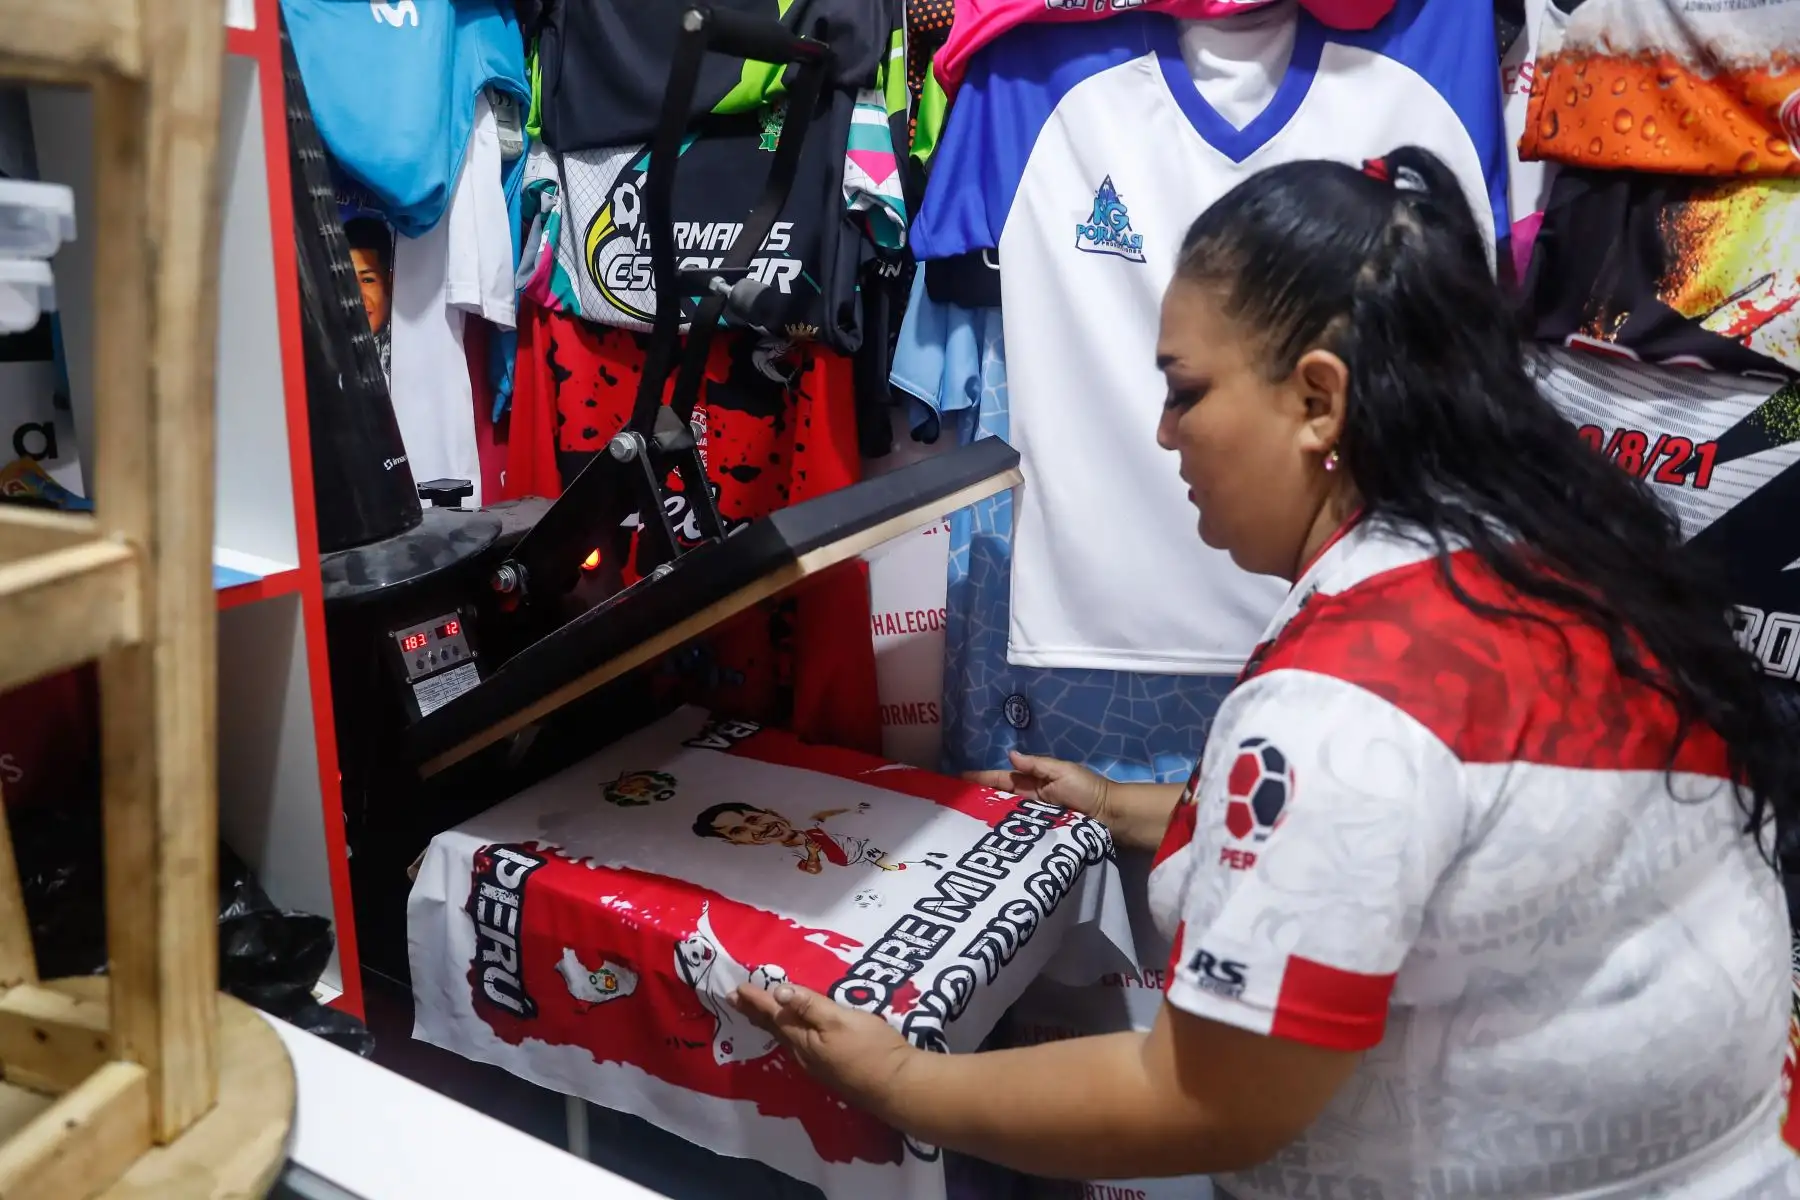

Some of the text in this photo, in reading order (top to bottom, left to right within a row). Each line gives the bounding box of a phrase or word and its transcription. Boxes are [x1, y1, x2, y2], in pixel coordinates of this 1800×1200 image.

[445, 621, 459, 636] 12
[915, 872, 995, 922] MI
[958, 798, 1067, 878] PECH
[960, 900, 1039, 985] TUS
[1188, 949, 1250, 985] RS
